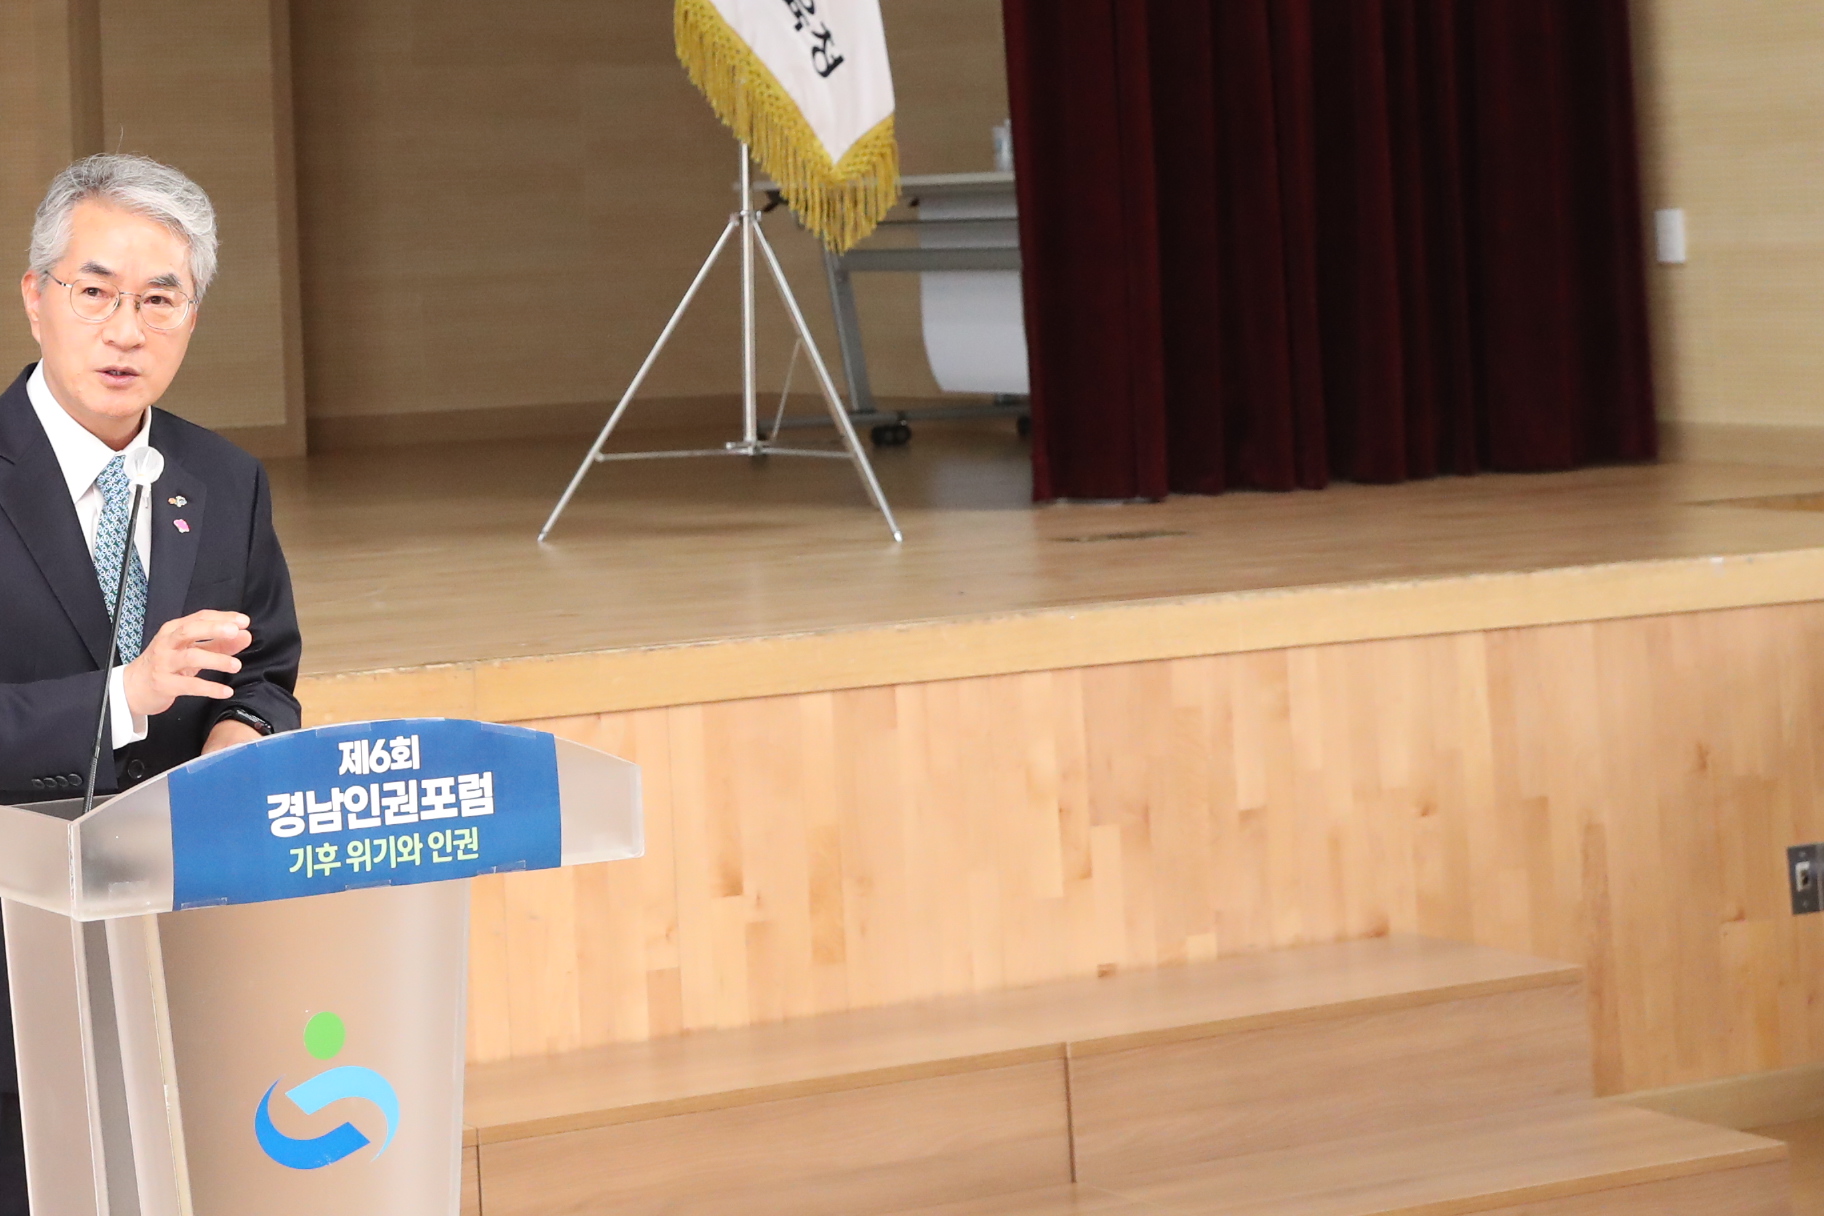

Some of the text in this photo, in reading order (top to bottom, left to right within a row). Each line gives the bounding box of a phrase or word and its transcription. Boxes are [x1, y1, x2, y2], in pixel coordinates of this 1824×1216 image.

[338, 734, 422, 776] 제6회
[266, 771, 495, 839] 경남인권포럼
[289, 826, 480, 879] 기후 위기와 인권
